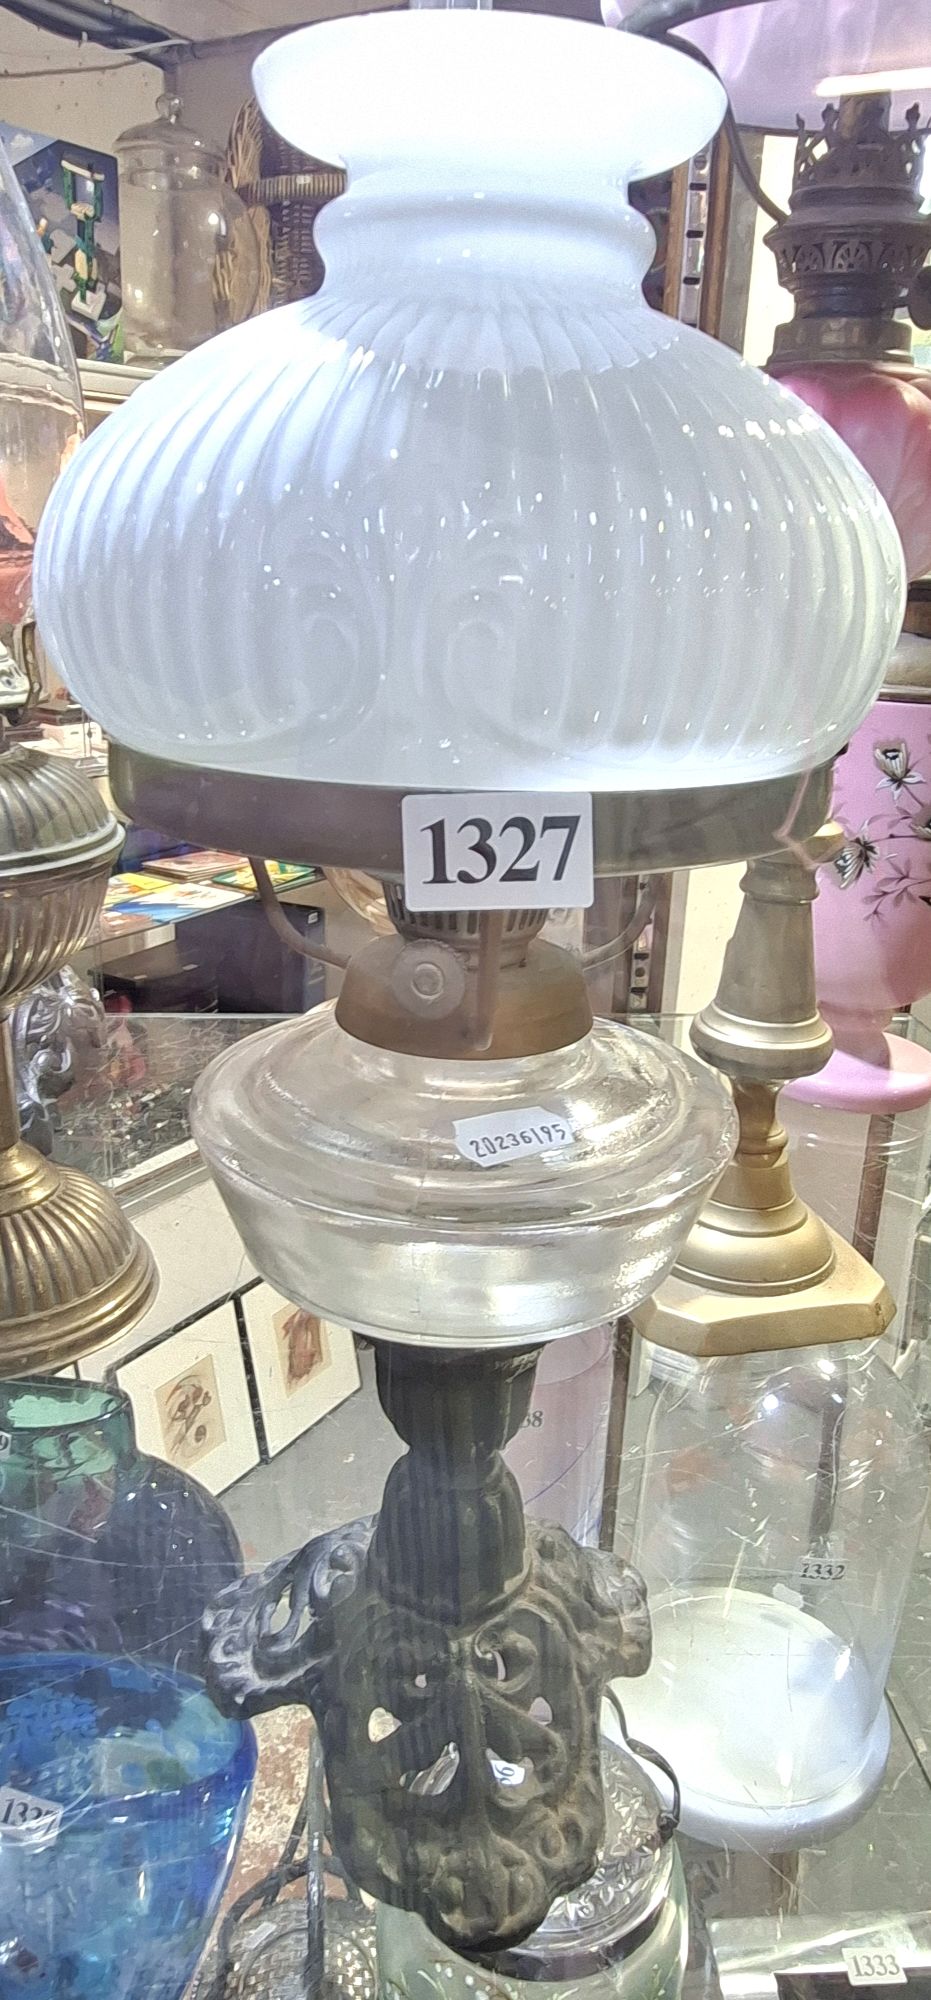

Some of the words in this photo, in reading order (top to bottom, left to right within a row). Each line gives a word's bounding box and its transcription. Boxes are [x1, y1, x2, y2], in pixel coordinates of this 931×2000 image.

[420, 815, 581, 884] 1327
[469, 1123, 566, 1158] 20236195
[801, 1563, 845, 1580] 1332
[848, 1954, 900, 1977] 1333
